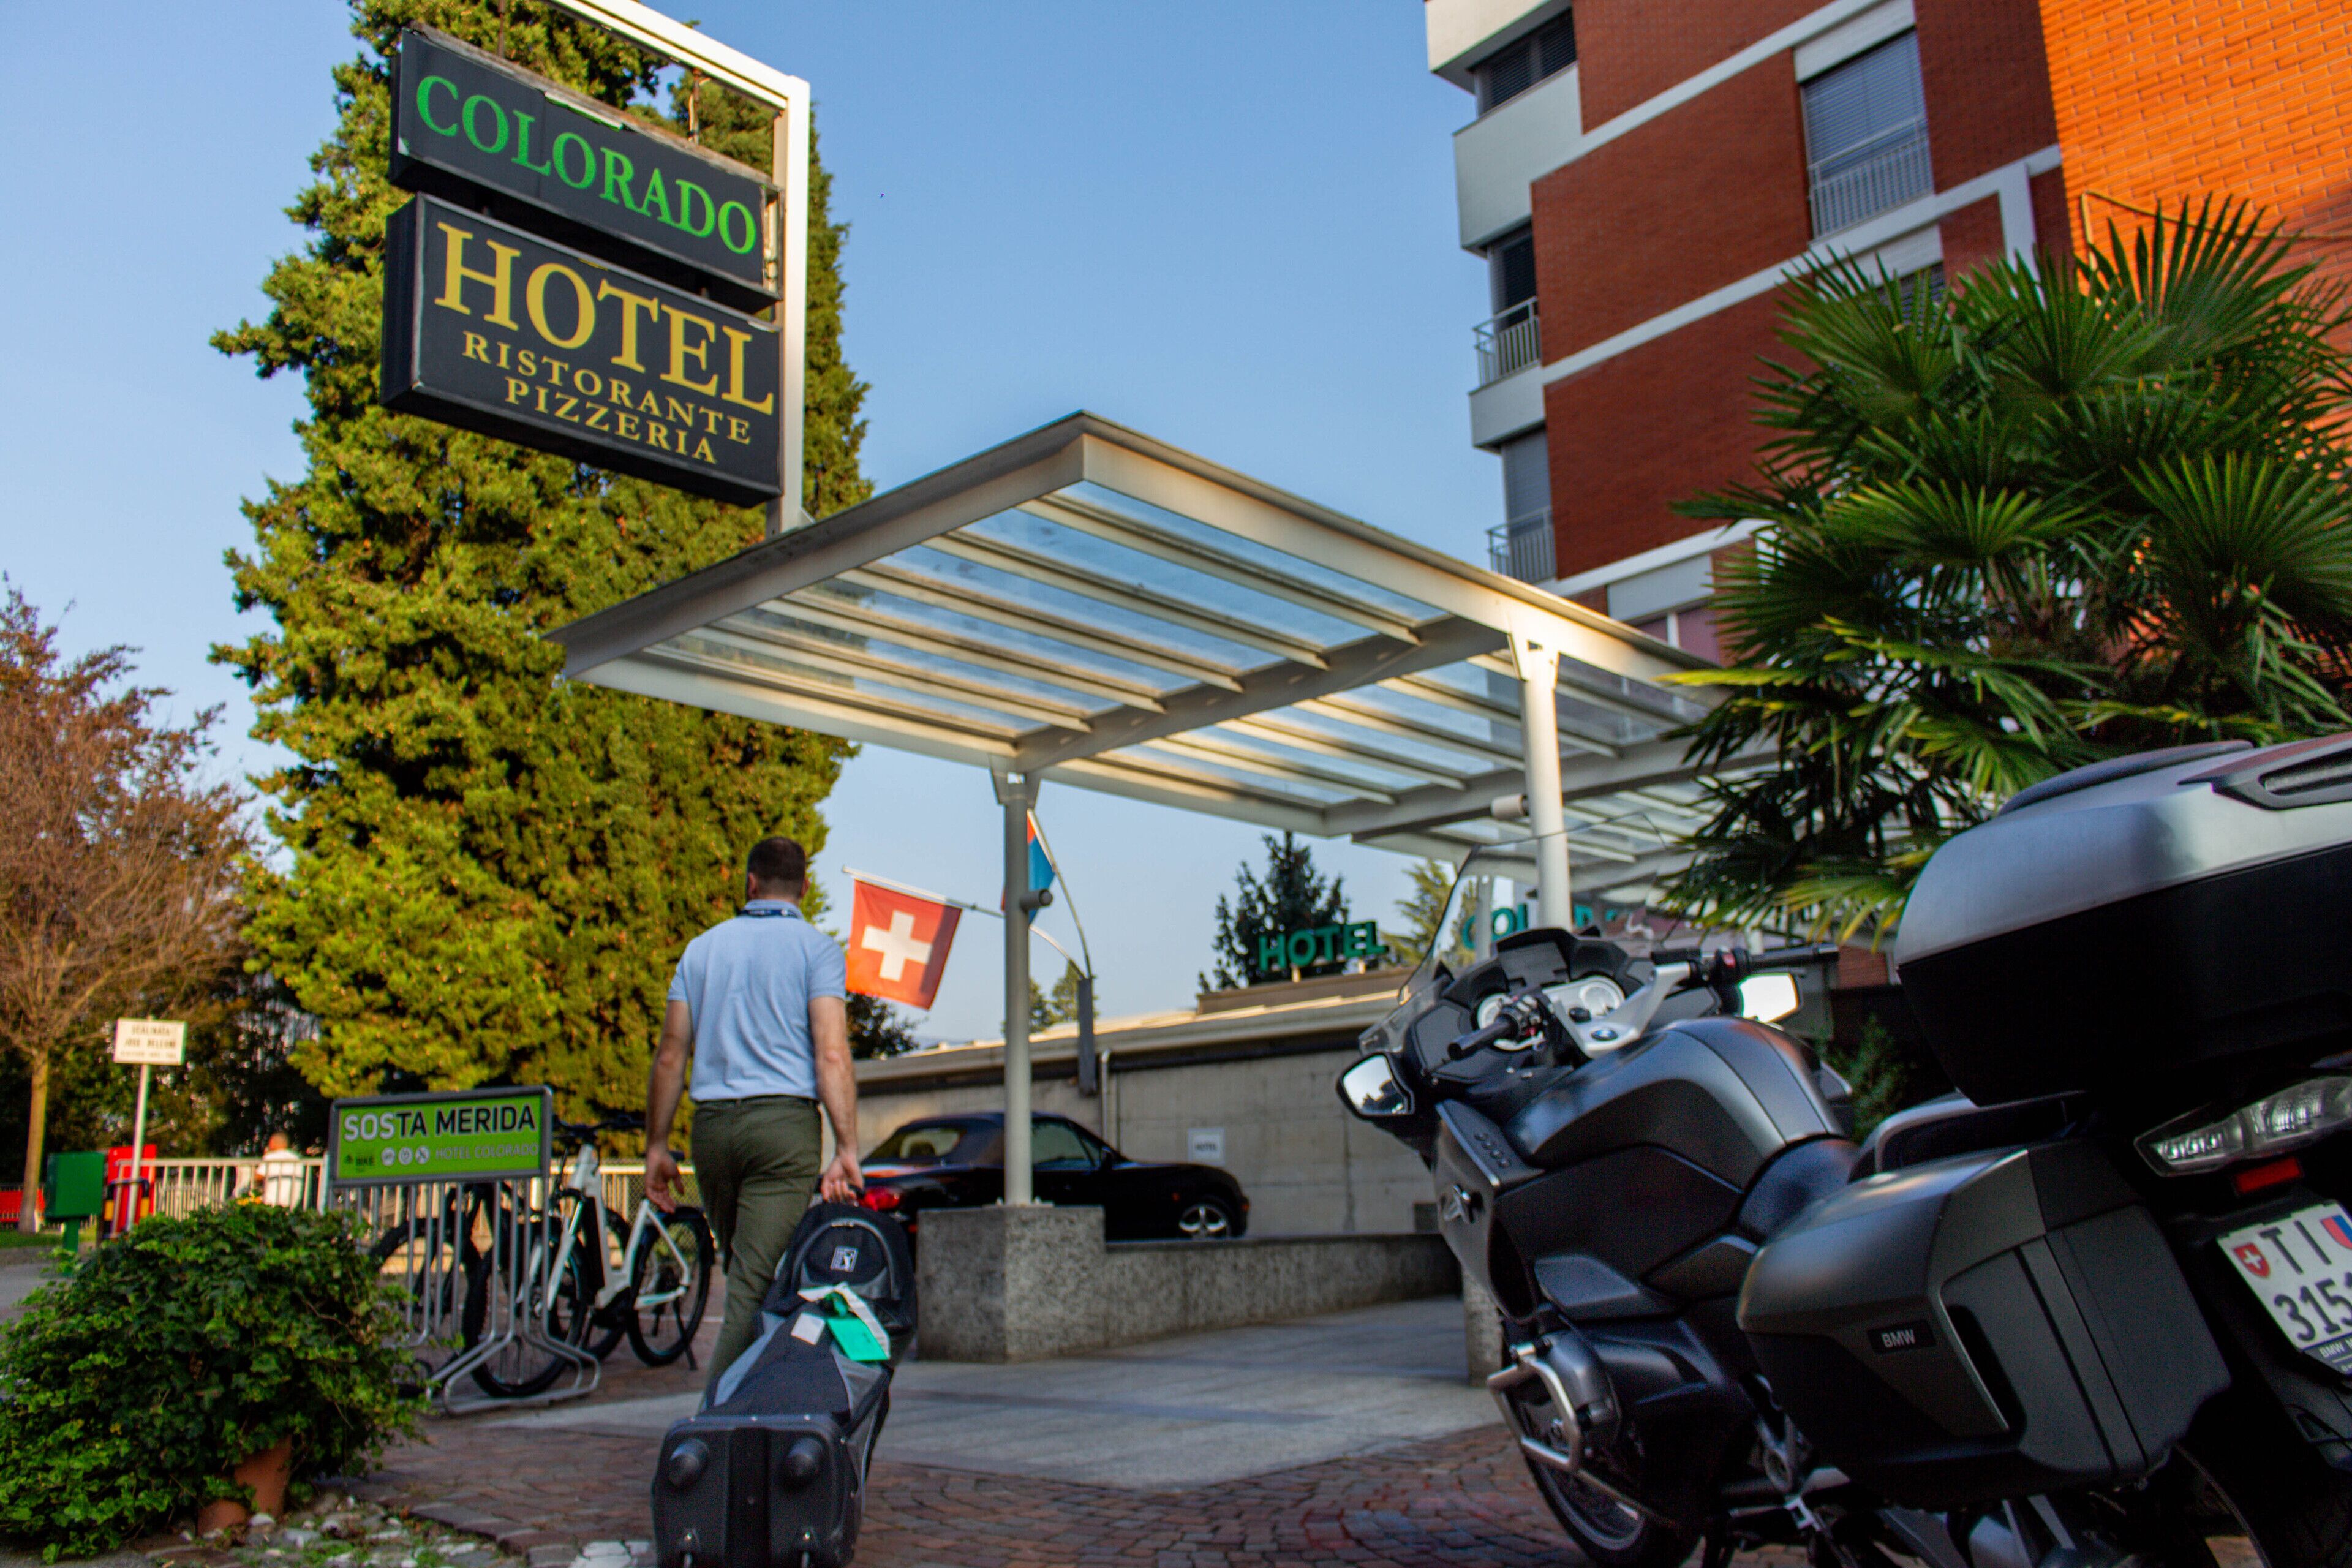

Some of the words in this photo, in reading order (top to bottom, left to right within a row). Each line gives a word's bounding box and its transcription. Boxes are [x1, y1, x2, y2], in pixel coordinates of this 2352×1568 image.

[416, 75, 756, 254] COLORADO
[434, 222, 775, 415] HOTEL
[462, 331, 751, 445] RISTORANTE
[505, 378, 718, 465] PIZZERIA
[1259, 921, 1389, 971] HOTEL
[344, 1111, 427, 1142] SOSTA
[435, 1106, 535, 1136] MERIDA
[435, 1147, 472, 1161] HOTEL
[475, 1142, 539, 1159] COLORADO
[2258, 1219, 2332, 1275] TI
[1882, 1328, 1915, 1348] BMW
[2319, 1341, 2345, 1359] BMW
